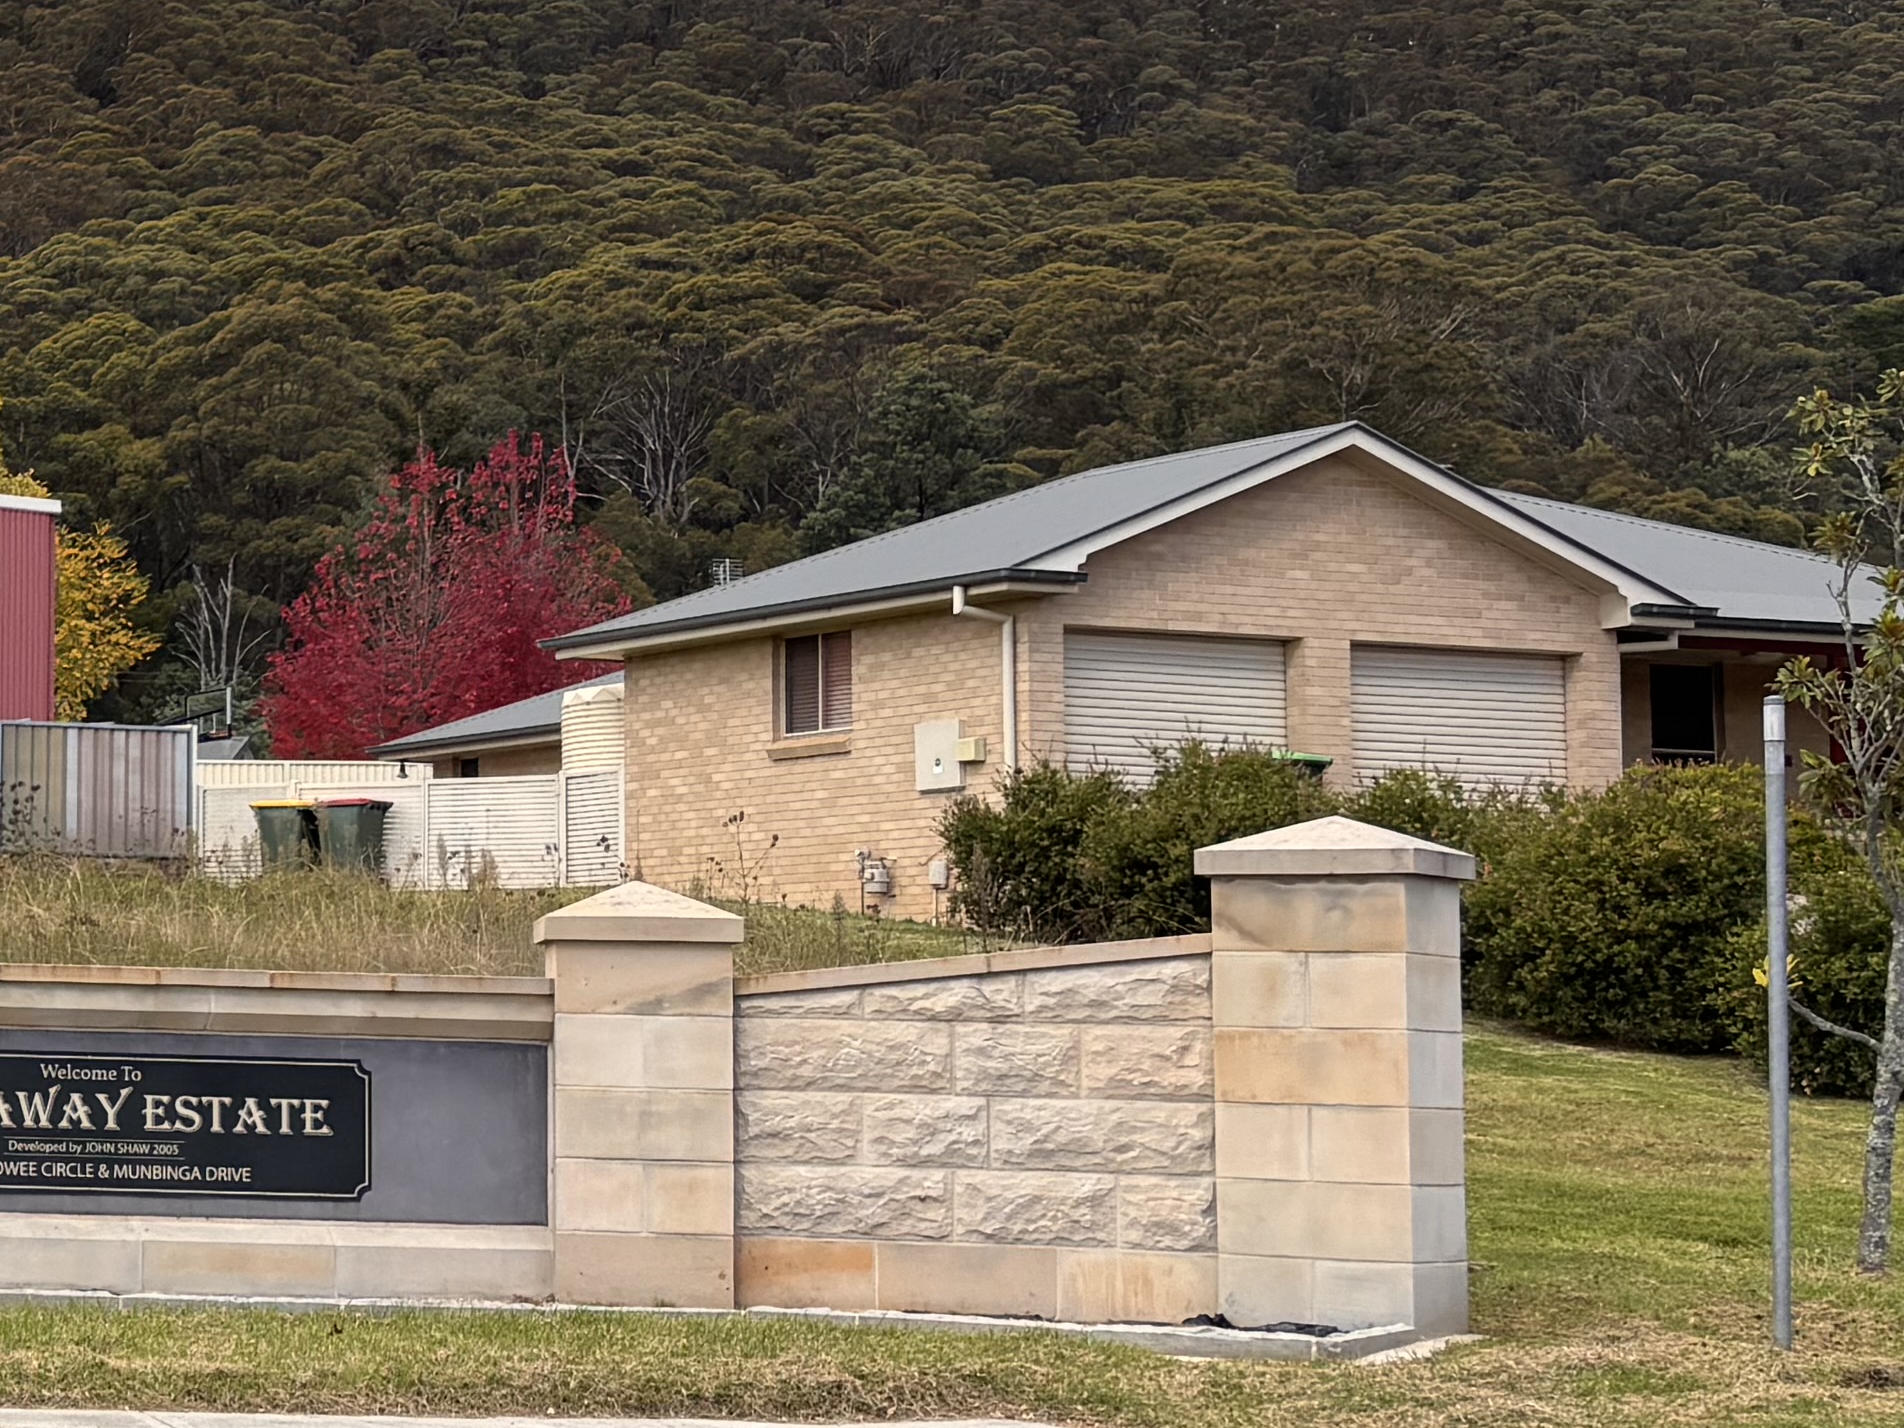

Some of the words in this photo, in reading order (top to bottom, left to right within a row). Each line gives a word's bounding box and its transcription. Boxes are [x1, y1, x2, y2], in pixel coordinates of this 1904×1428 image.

[40, 1063, 117, 1081] Welcome
[120, 1065, 142, 1082] To
[141, 1094, 334, 1137] ESTATE
[8, 1139, 66, 1155] Developed
[69, 1141, 83, 1156] by
[85, 1141, 115, 1154] JOHN
[117, 1142, 150, 1155] SHAW
[152, 1144, 179, 1155] 2005
[41, 1162, 94, 1178] CIRCLE
[97, 1163, 110, 1179] &
[113, 1164, 202, 1181] MUNBINGA
[205, 1166, 252, 1182] DRIVE
